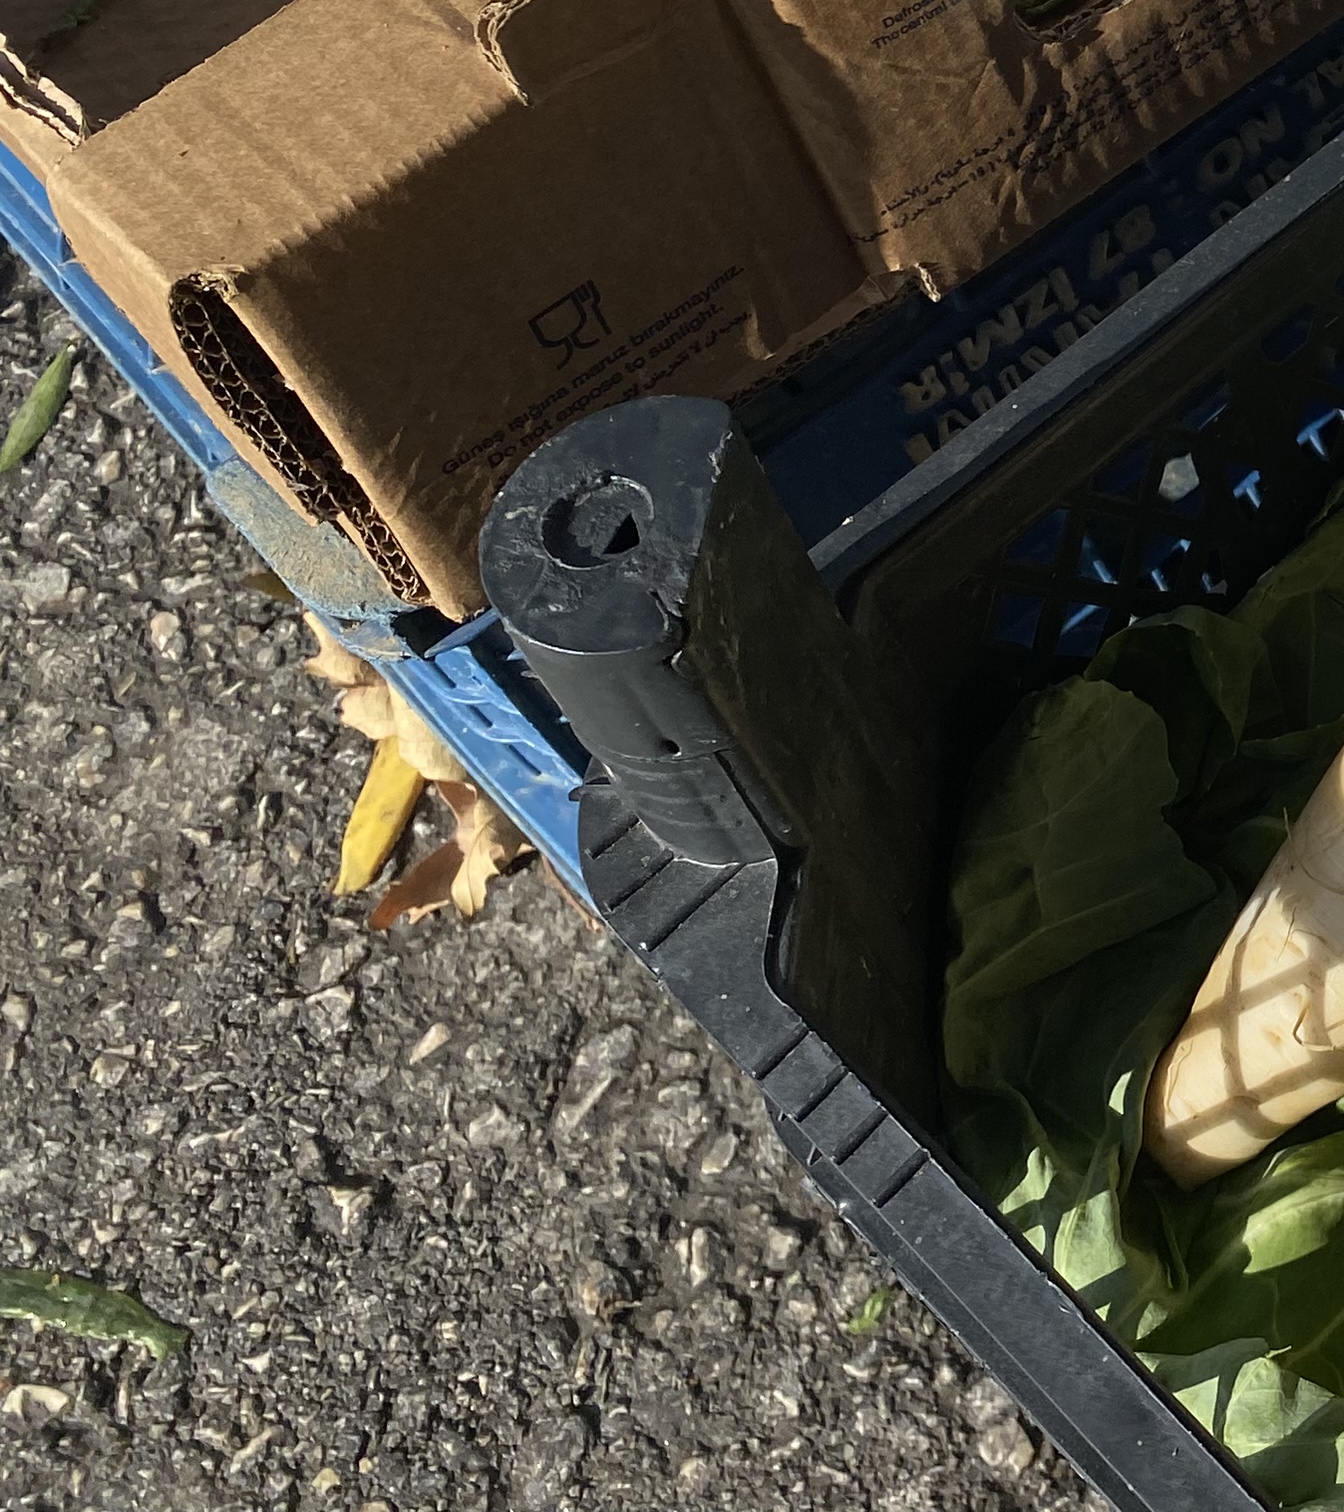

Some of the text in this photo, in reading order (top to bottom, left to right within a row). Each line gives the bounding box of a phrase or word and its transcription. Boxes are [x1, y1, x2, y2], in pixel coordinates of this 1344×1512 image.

[871, 31, 900, 49] The
[442, 430, 505, 475] Güneş
[507, 387, 570, 432] ışığına
[571, 345, 630, 389] maruz
[629, 265, 744, 347] bırakmayınız.
[487, 445, 517, 468] Do
[519, 419, 553, 447] not
[556, 372, 623, 422] expose
[624, 356, 646, 373] to
[648, 303, 724, 359] sunlight.
